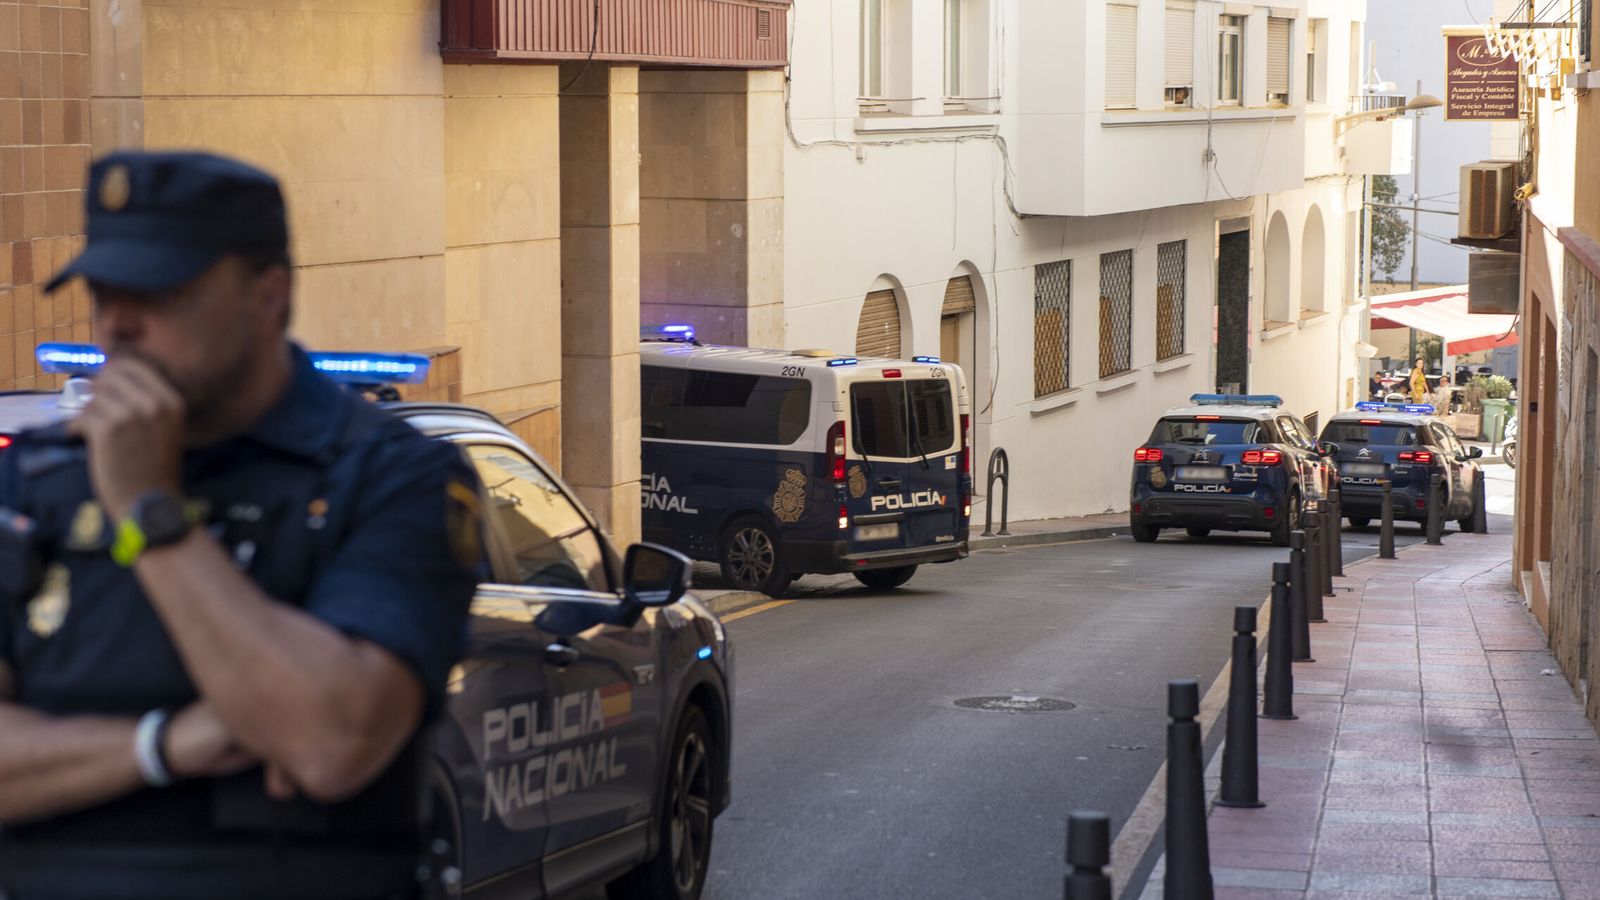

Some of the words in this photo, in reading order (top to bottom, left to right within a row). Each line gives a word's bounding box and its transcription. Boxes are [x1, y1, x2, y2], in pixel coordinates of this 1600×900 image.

[781, 366, 805, 377] 2GN
[641, 472, 671, 493] CÍA
[1173, 483, 1227, 493] POLICÍA
[641, 491, 698, 514] ONAL
[870, 488, 942, 511] POLICÍA
[482, 736, 627, 821] NACIONAL
